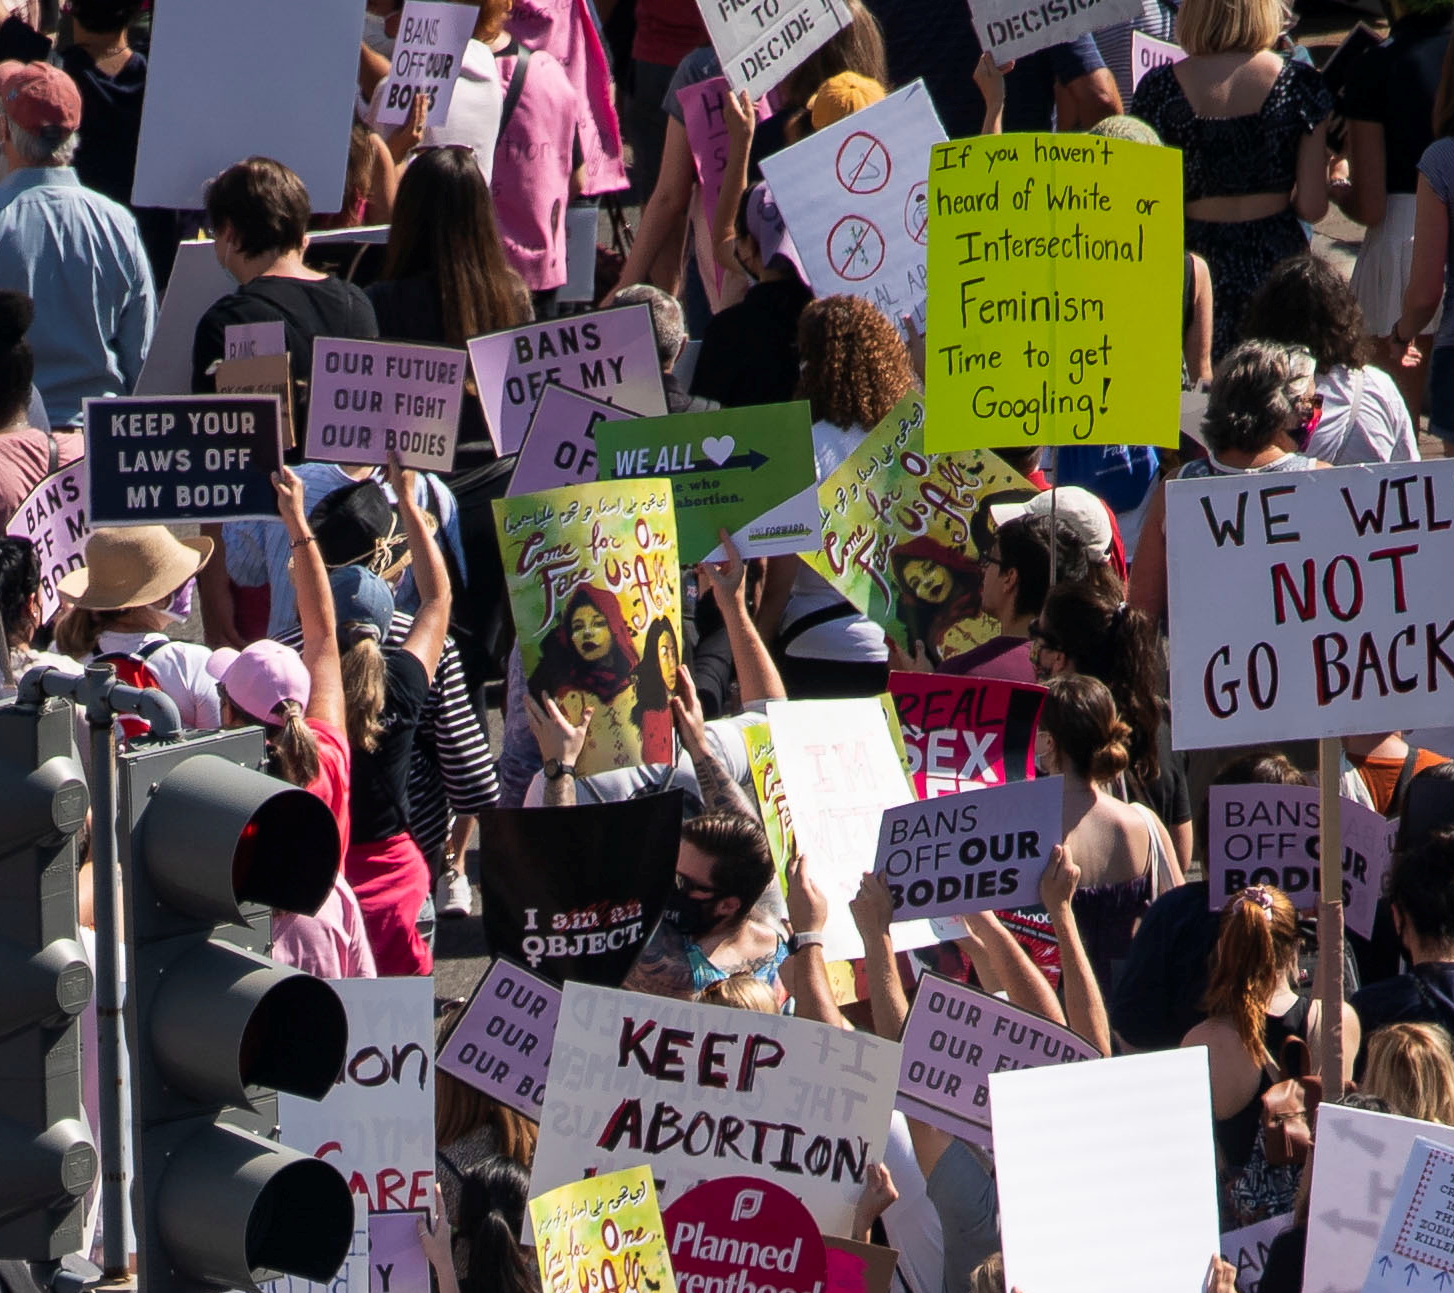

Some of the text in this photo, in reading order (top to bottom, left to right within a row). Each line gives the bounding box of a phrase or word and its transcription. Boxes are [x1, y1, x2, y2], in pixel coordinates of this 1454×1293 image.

[936, 138, 1114, 174] If you haven't
[937, 178, 1160, 217] heard of White or
[955, 224, 1144, 265] Intersectional
[960, 277, 1105, 328] Feminism
[938, 335, 1112, 384] Time to get
[112, 412, 255, 437] KEEP YOUR
[972, 378, 1111, 439] Googling!
[118, 448, 251, 472] LAWS OFF
[127, 484, 245, 508] MY BODY
[1199, 486, 1300, 548] WE
[1271, 545, 1419, 625] NOT
[1203, 639, 1278, 719] GO
[672, 1222, 801, 1272] Planned
